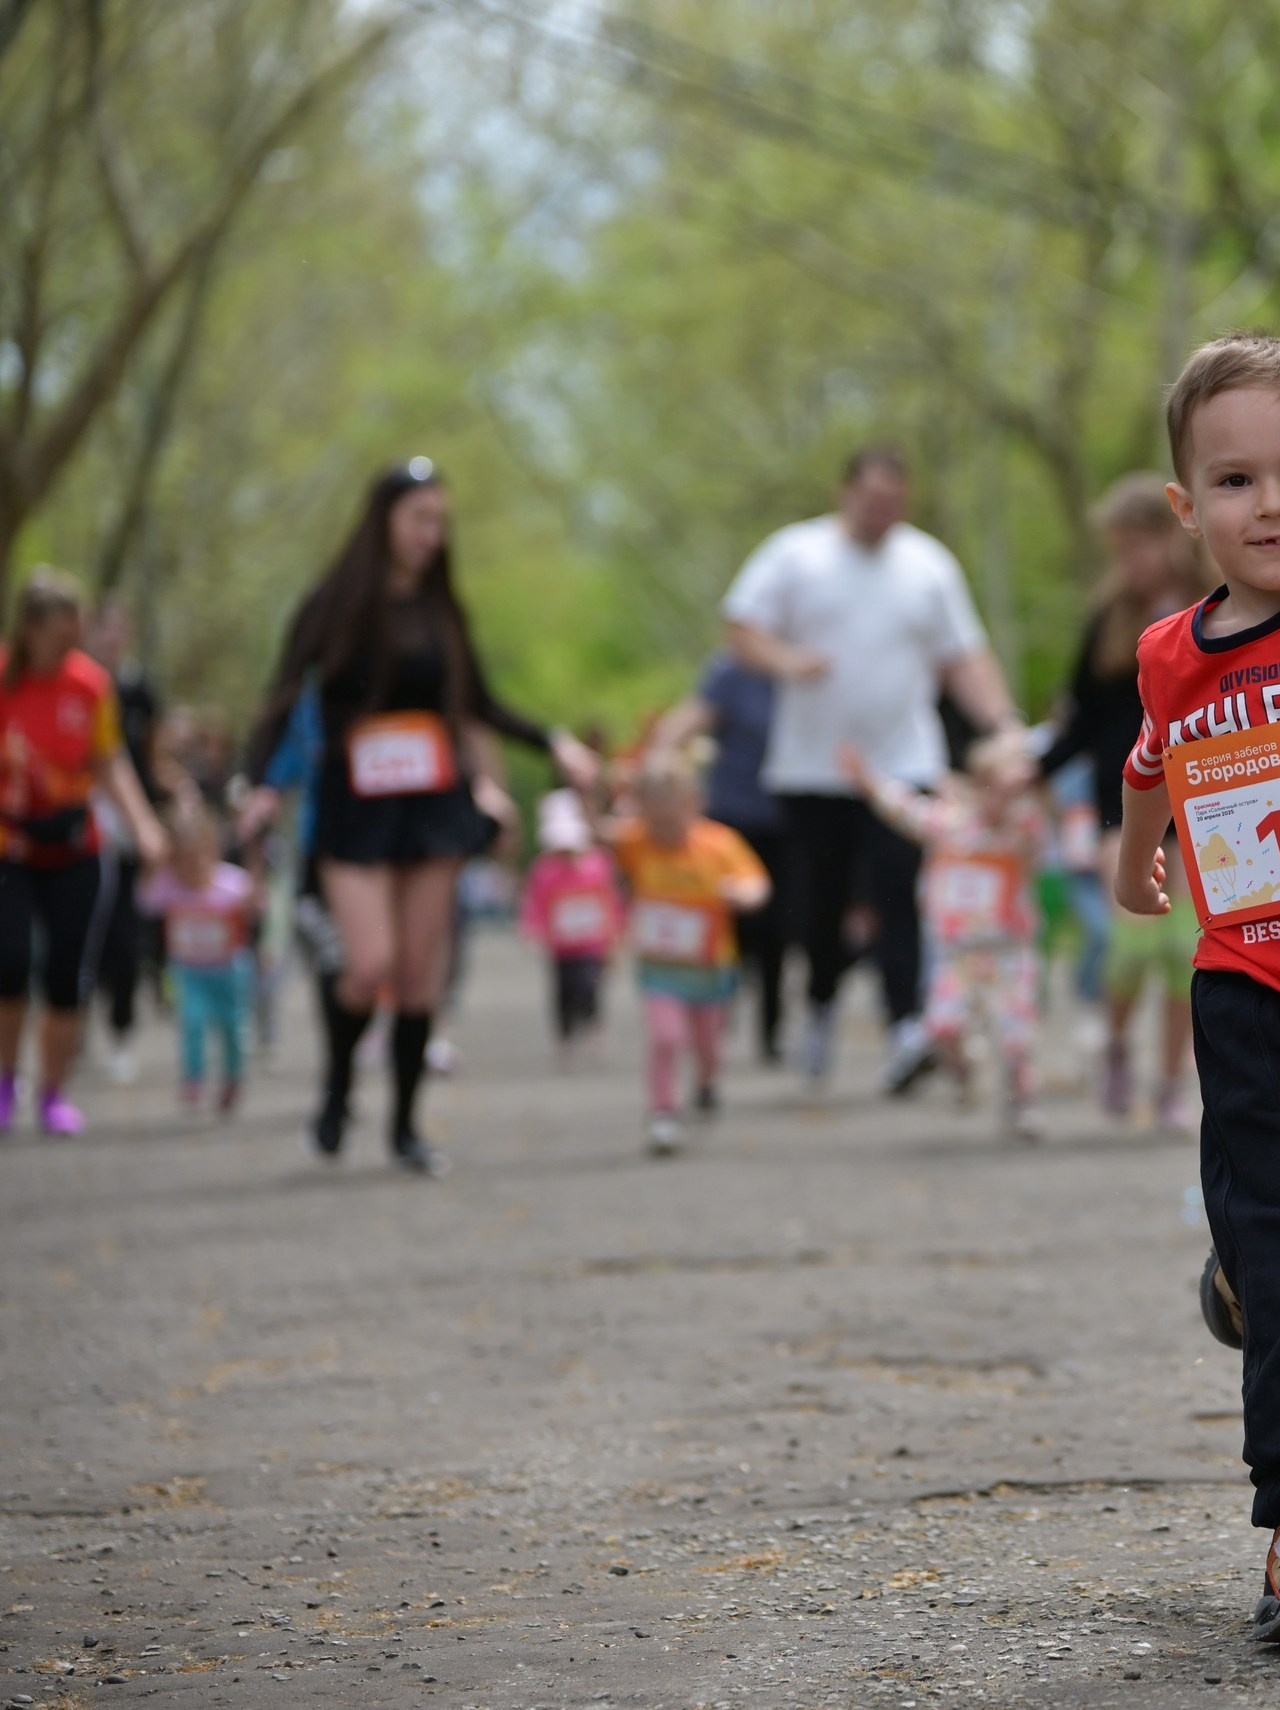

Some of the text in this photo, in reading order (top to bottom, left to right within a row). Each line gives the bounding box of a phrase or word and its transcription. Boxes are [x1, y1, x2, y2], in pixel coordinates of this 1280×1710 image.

[1201, 742, 1278, 766] серия забегов
[1185, 760, 1202, 785] 5
[1194, 801, 1220, 810] Краснодар
[1221, 809, 1235, 817] 2025
